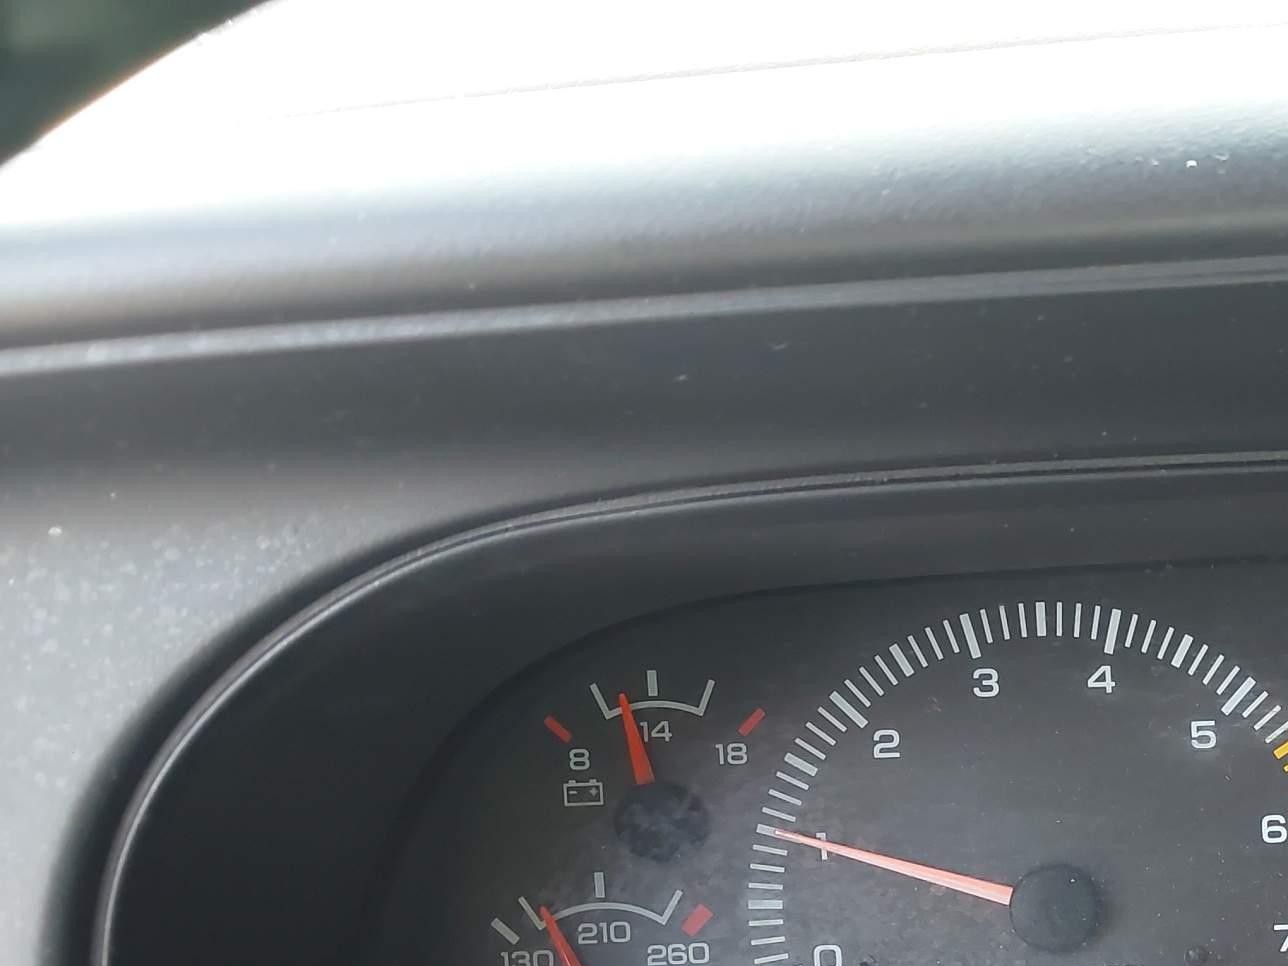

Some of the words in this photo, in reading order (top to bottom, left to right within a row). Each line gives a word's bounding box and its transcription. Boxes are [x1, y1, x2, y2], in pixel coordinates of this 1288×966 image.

[972, 668, 999, 697] 3
[1087, 665, 1116, 693] 4
[640, 720, 672, 742] 14
[1191, 721, 1217, 749] 5
[715, 744, 747, 765] 18
[873, 730, 901, 758] 2
[569, 748, 590, 770] 8
[1261, 815, 1287, 843] 6
[578, 922, 631, 944] 210
[646, 944, 710, 965] 260
